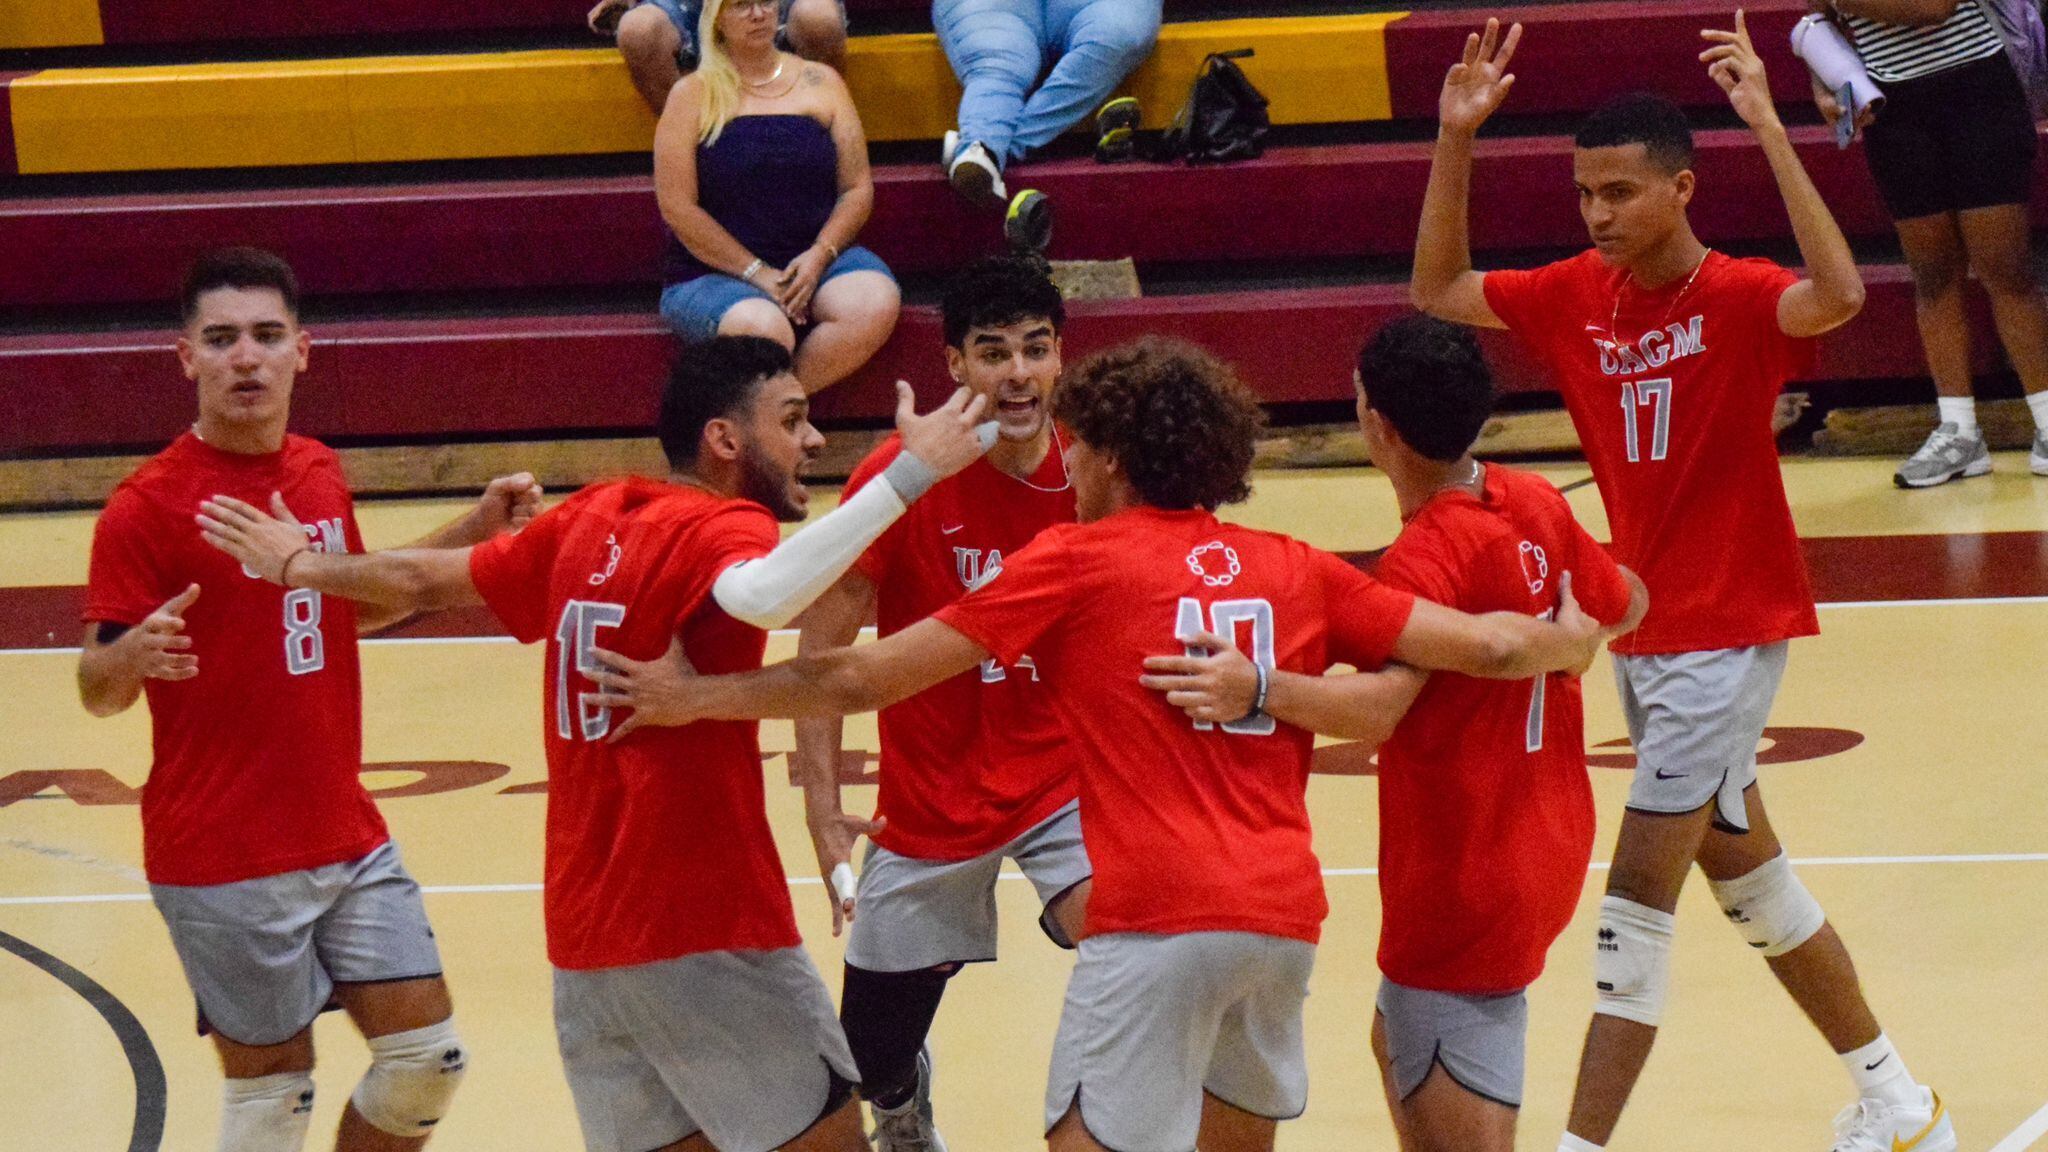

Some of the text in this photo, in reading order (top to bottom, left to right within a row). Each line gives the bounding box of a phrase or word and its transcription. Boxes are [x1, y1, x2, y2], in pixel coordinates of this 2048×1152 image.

[1593, 315, 1707, 375] UAGM
[1621, 378, 1672, 462] 17
[284, 588, 325, 675] 8
[556, 599, 627, 742] 15
